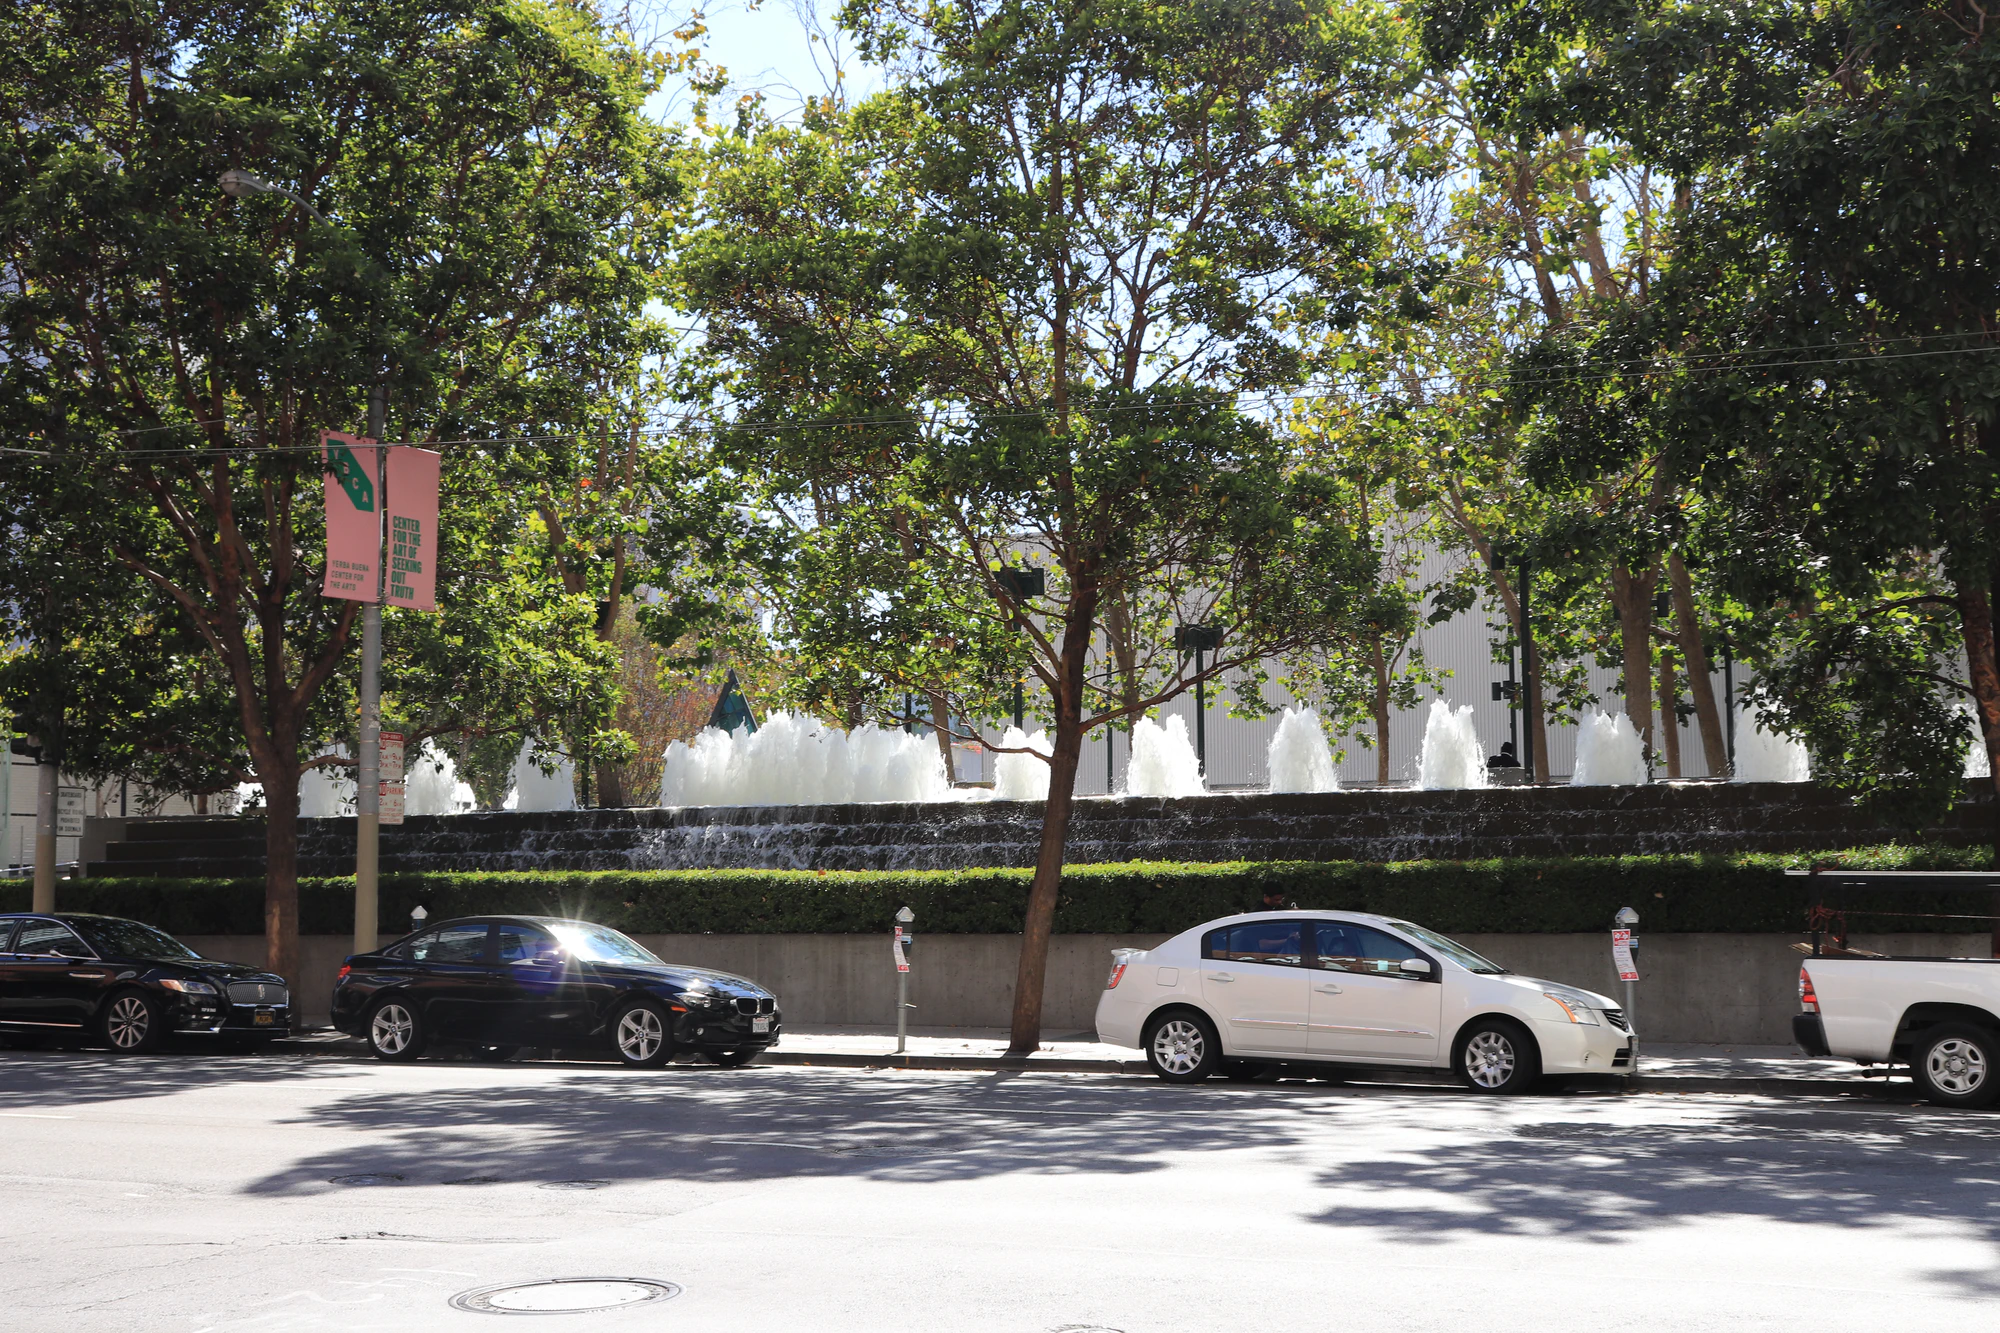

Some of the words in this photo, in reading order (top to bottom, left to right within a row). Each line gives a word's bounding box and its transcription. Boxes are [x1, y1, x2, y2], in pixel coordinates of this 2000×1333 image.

[393, 515, 420, 533] CENTER
[393, 529, 407, 544] FOR
[408, 531, 421, 547] THE
[392, 543, 407, 558] ART
[408, 545, 417, 559] OF
[332, 560, 350, 569] YERBA
[351, 562, 369, 572] BUENA
[392, 557, 422, 574] SEEKING
[331, 570, 353, 580] CENTER
[353, 574, 364, 582] FOR
[391, 570, 407, 585] OUT
[330, 581, 341, 589] THE
[341, 582, 356, 591] ARTS
[390, 583, 414, 600] TRUTH
[387, 787, 404, 795] PARKING
